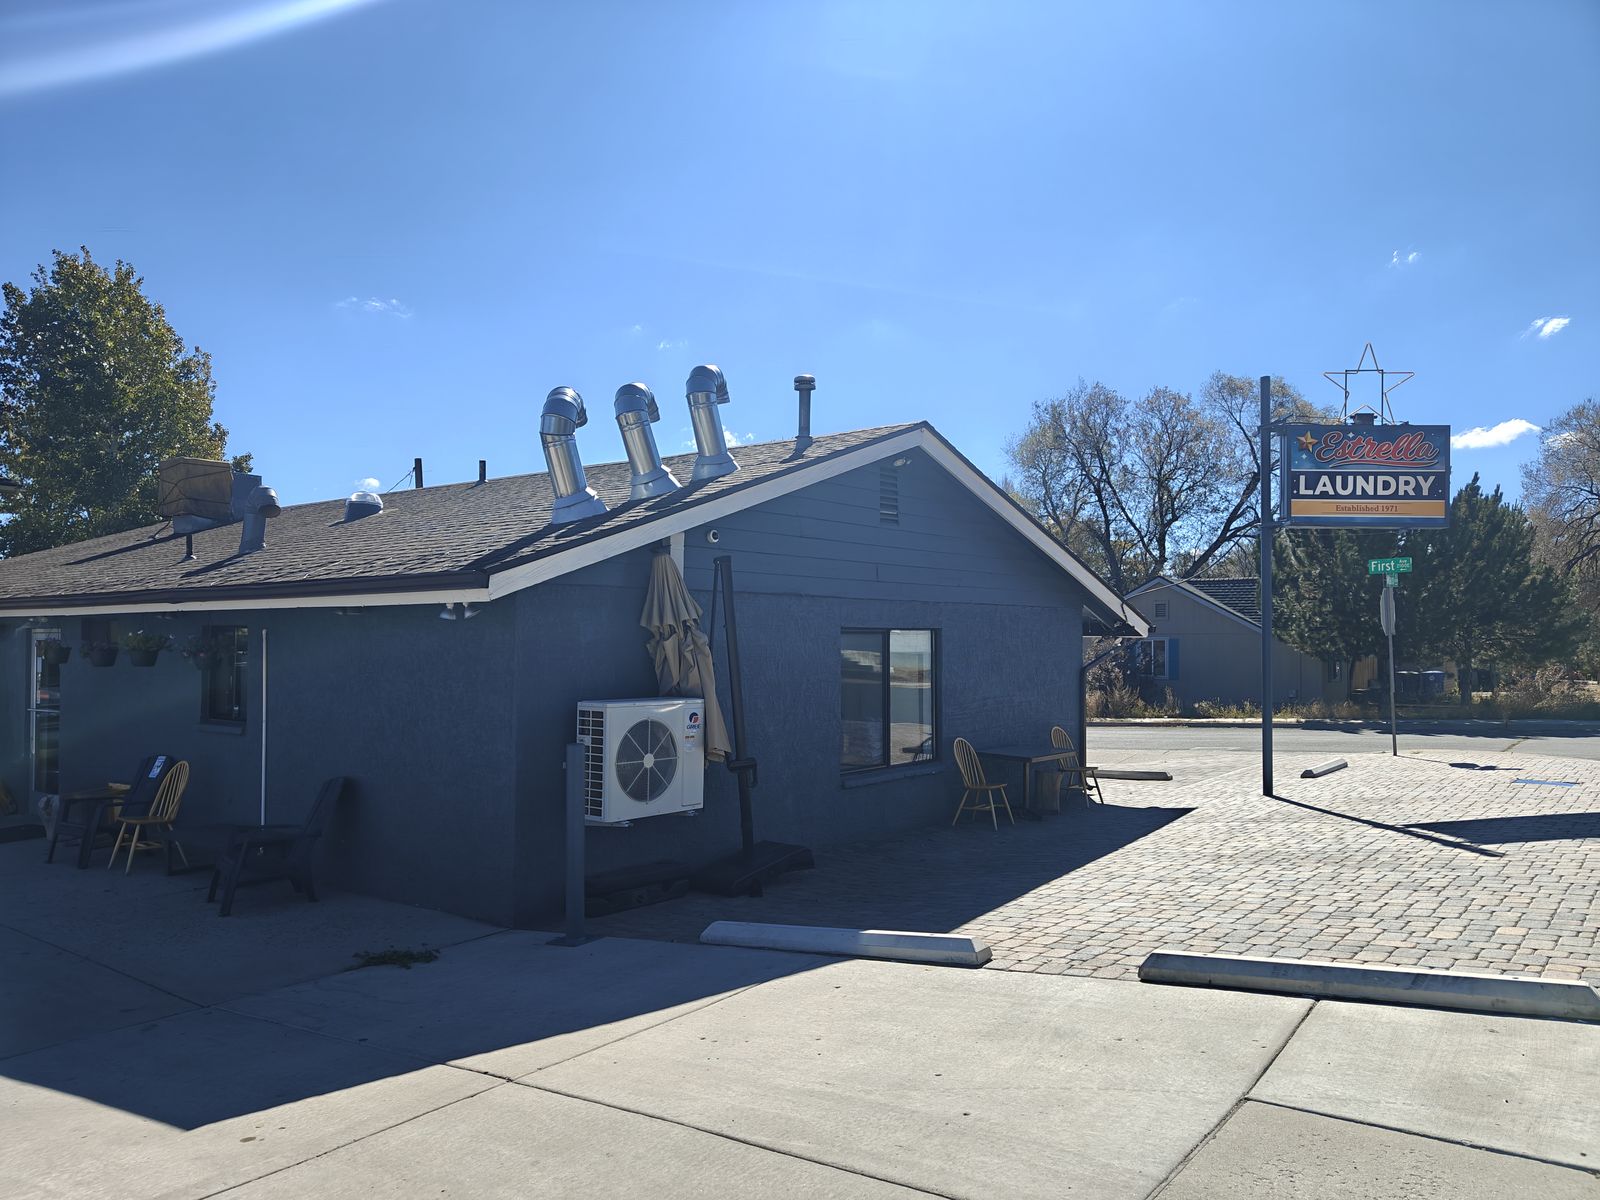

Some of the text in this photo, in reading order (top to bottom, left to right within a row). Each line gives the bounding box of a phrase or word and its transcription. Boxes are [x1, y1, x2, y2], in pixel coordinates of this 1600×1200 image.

[1315, 431, 1439, 462] Estrella
[1299, 475, 1436, 496] LAUNDRY
[1335, 504, 1379, 512] Established
[1371, 561, 1395, 571] First
